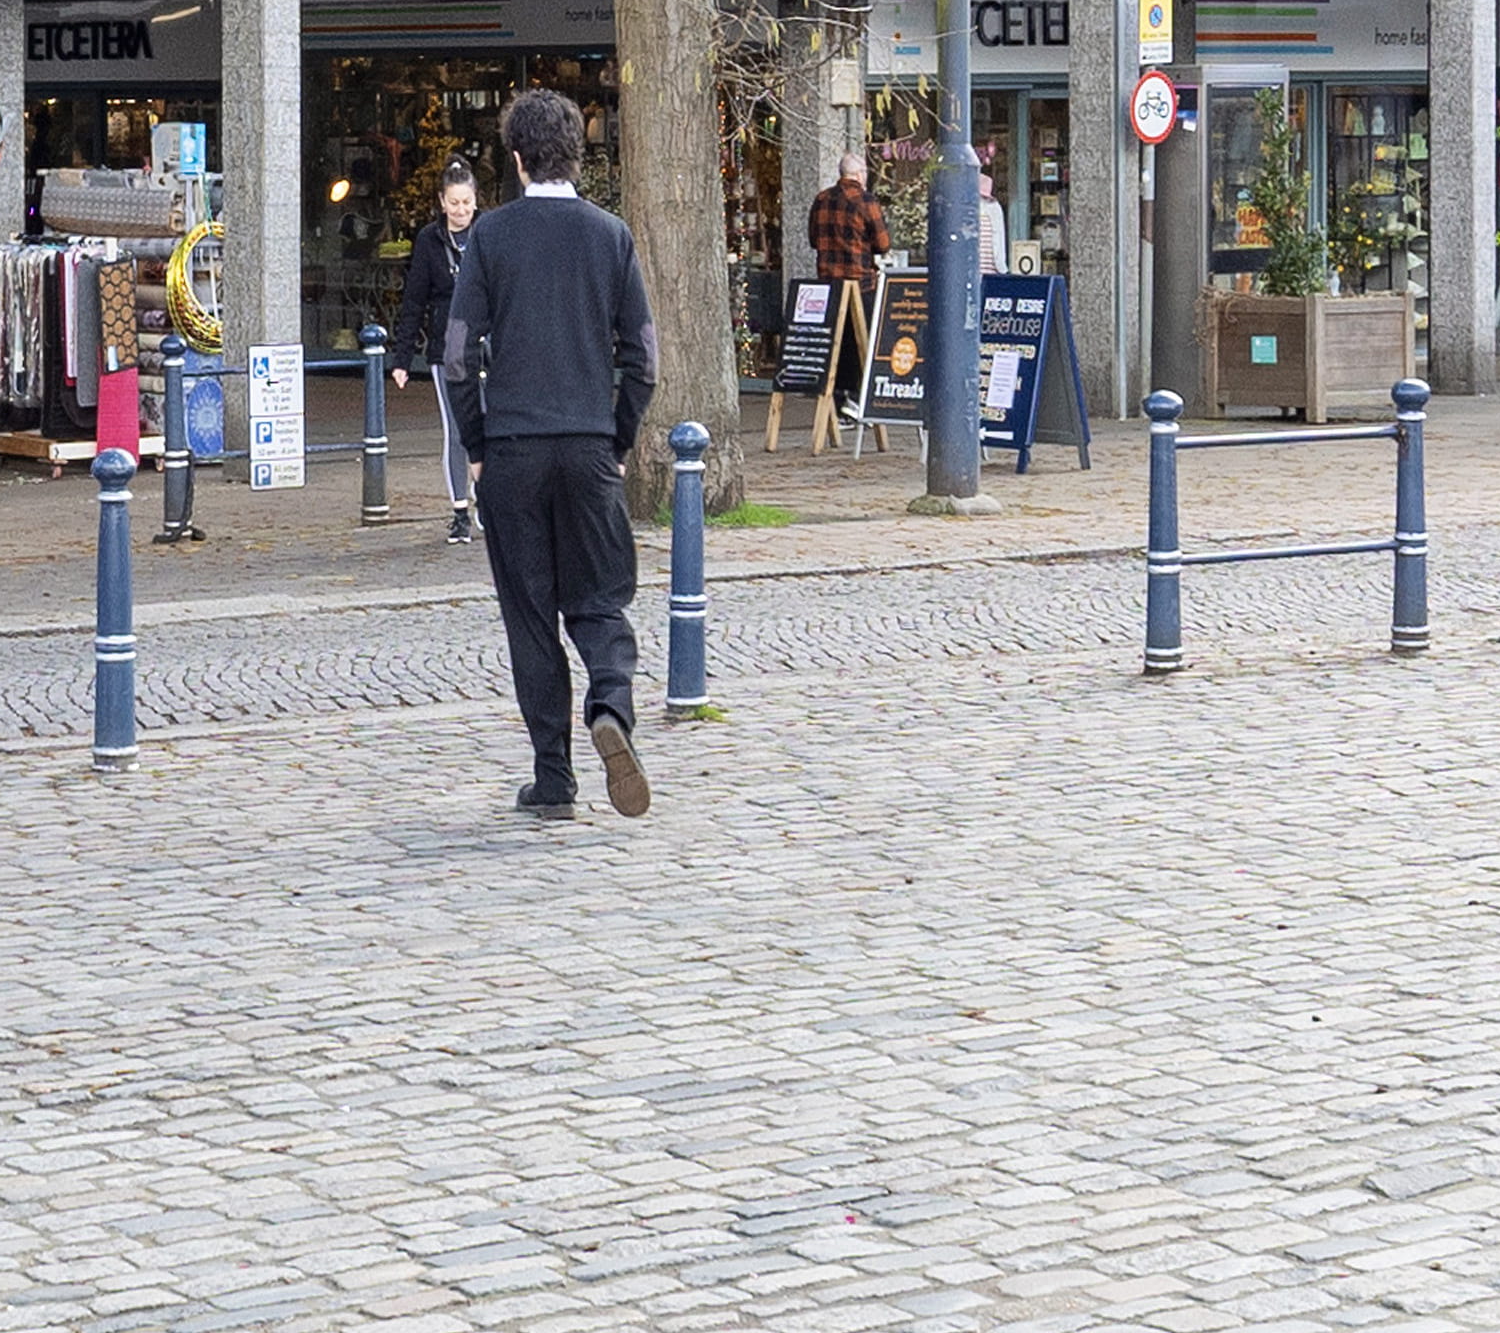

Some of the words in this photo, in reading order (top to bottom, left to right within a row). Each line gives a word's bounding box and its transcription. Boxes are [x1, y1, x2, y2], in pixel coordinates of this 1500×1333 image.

[27, 20, 153, 60] ETCETERA
[1375, 28, 1407, 46] home
[982, 310, 1041, 337] Bakehouse
[874, 376, 924, 399] Threads
